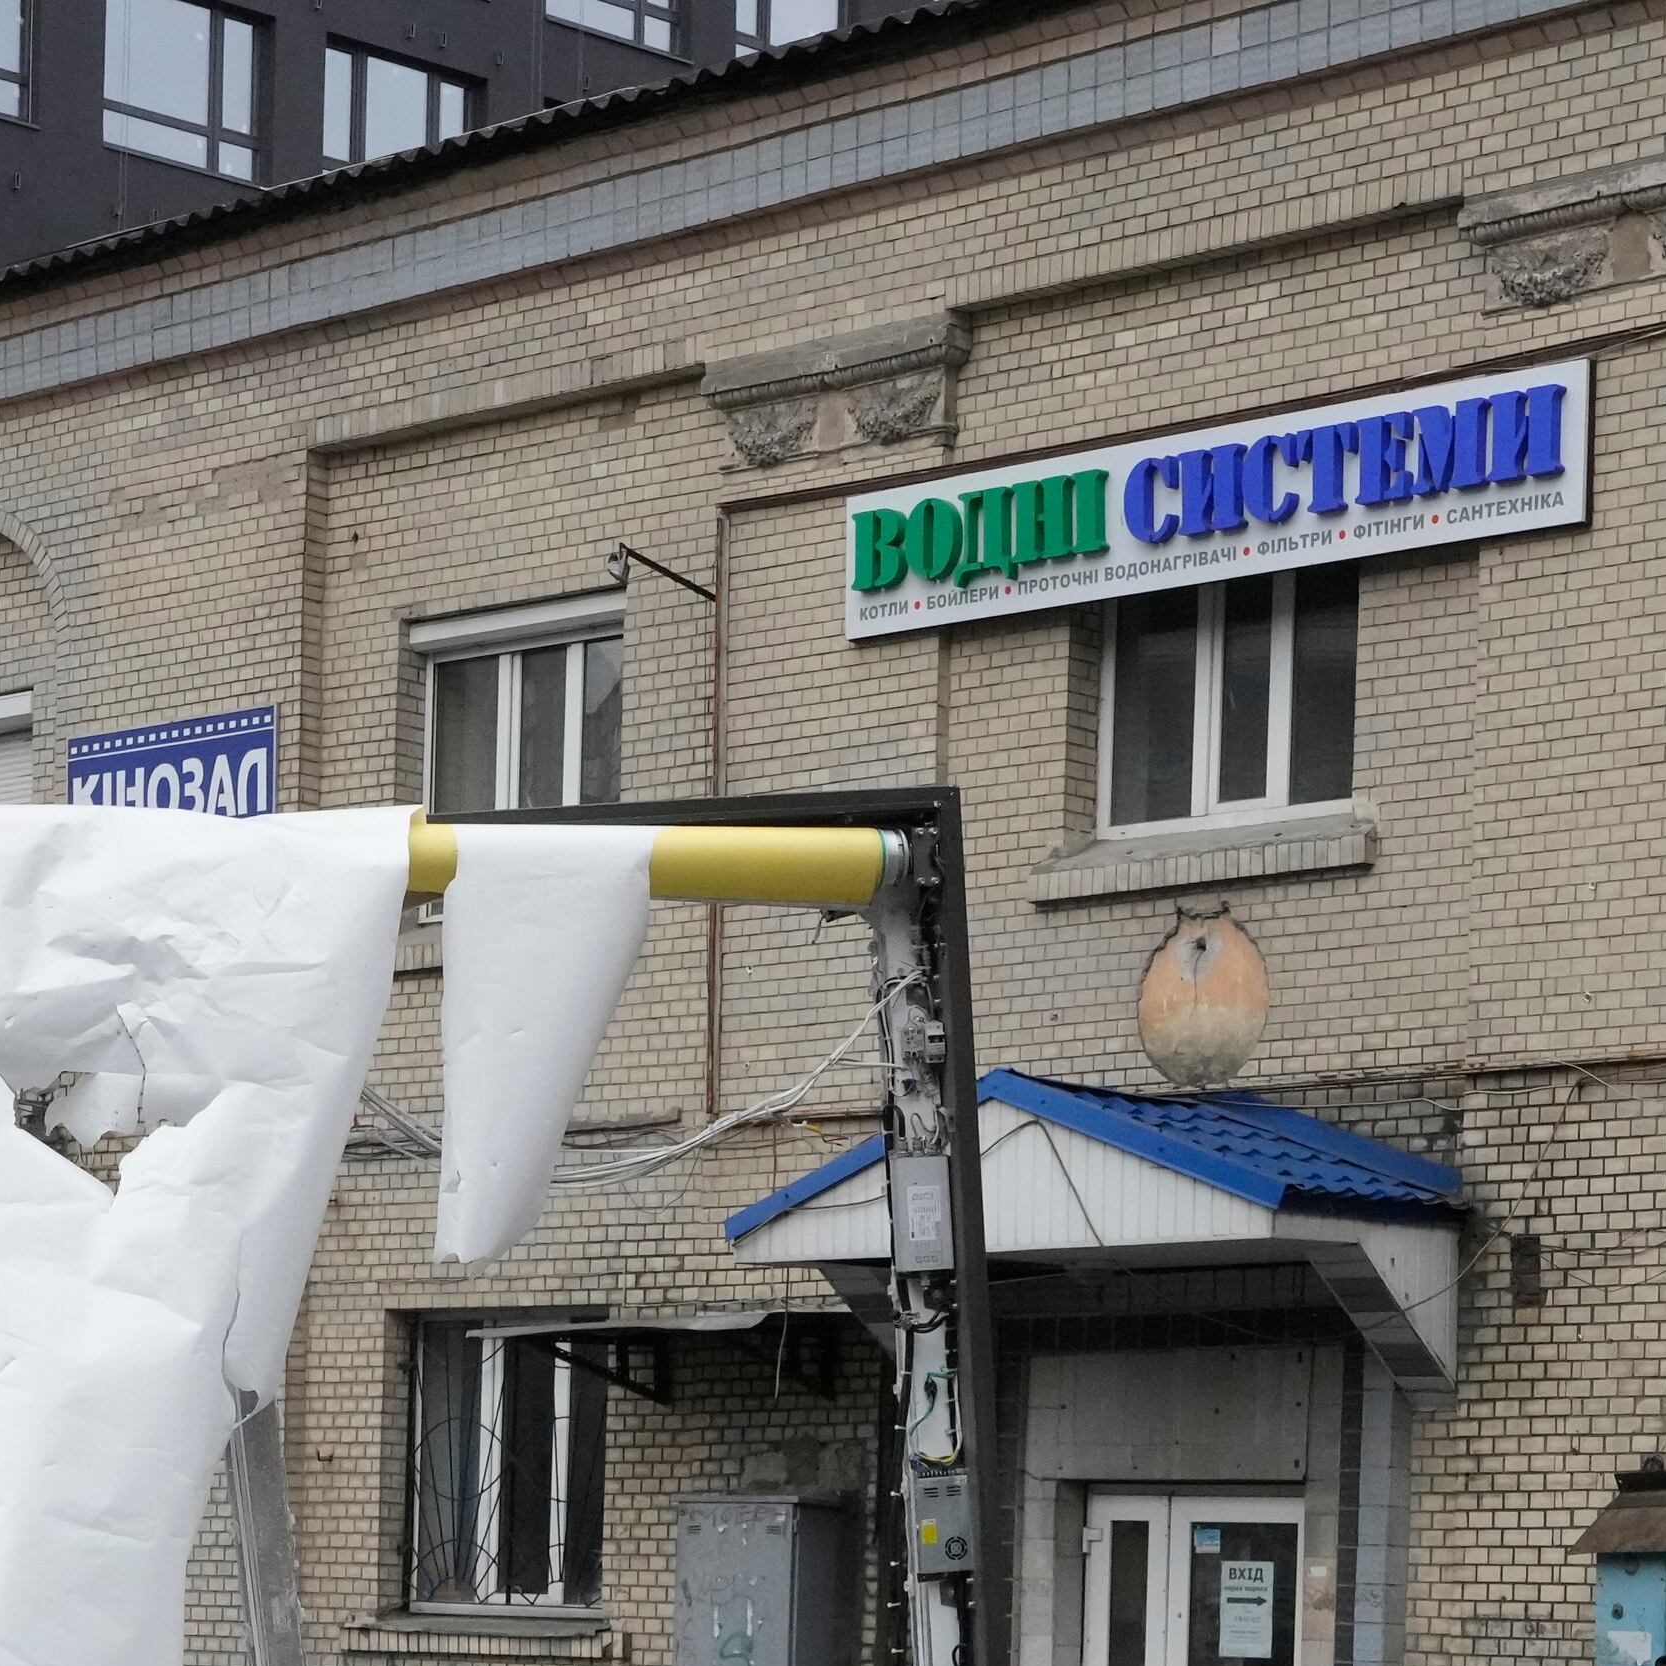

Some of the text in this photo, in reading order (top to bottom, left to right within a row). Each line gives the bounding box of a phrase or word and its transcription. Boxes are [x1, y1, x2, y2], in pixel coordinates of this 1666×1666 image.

[851, 383, 1567, 592] ВОДНІ СИСТЕМИ
[859, 490, 1565, 622] КОТЛИ БОЙЛЕРИ ПРОТОЧНІ ВОДОНАГРІВАЧІ ФІЛЬТРИ ФІТІНГИ САНТЕХНІКА
[1228, 1567, 1265, 1583] ВХІД
